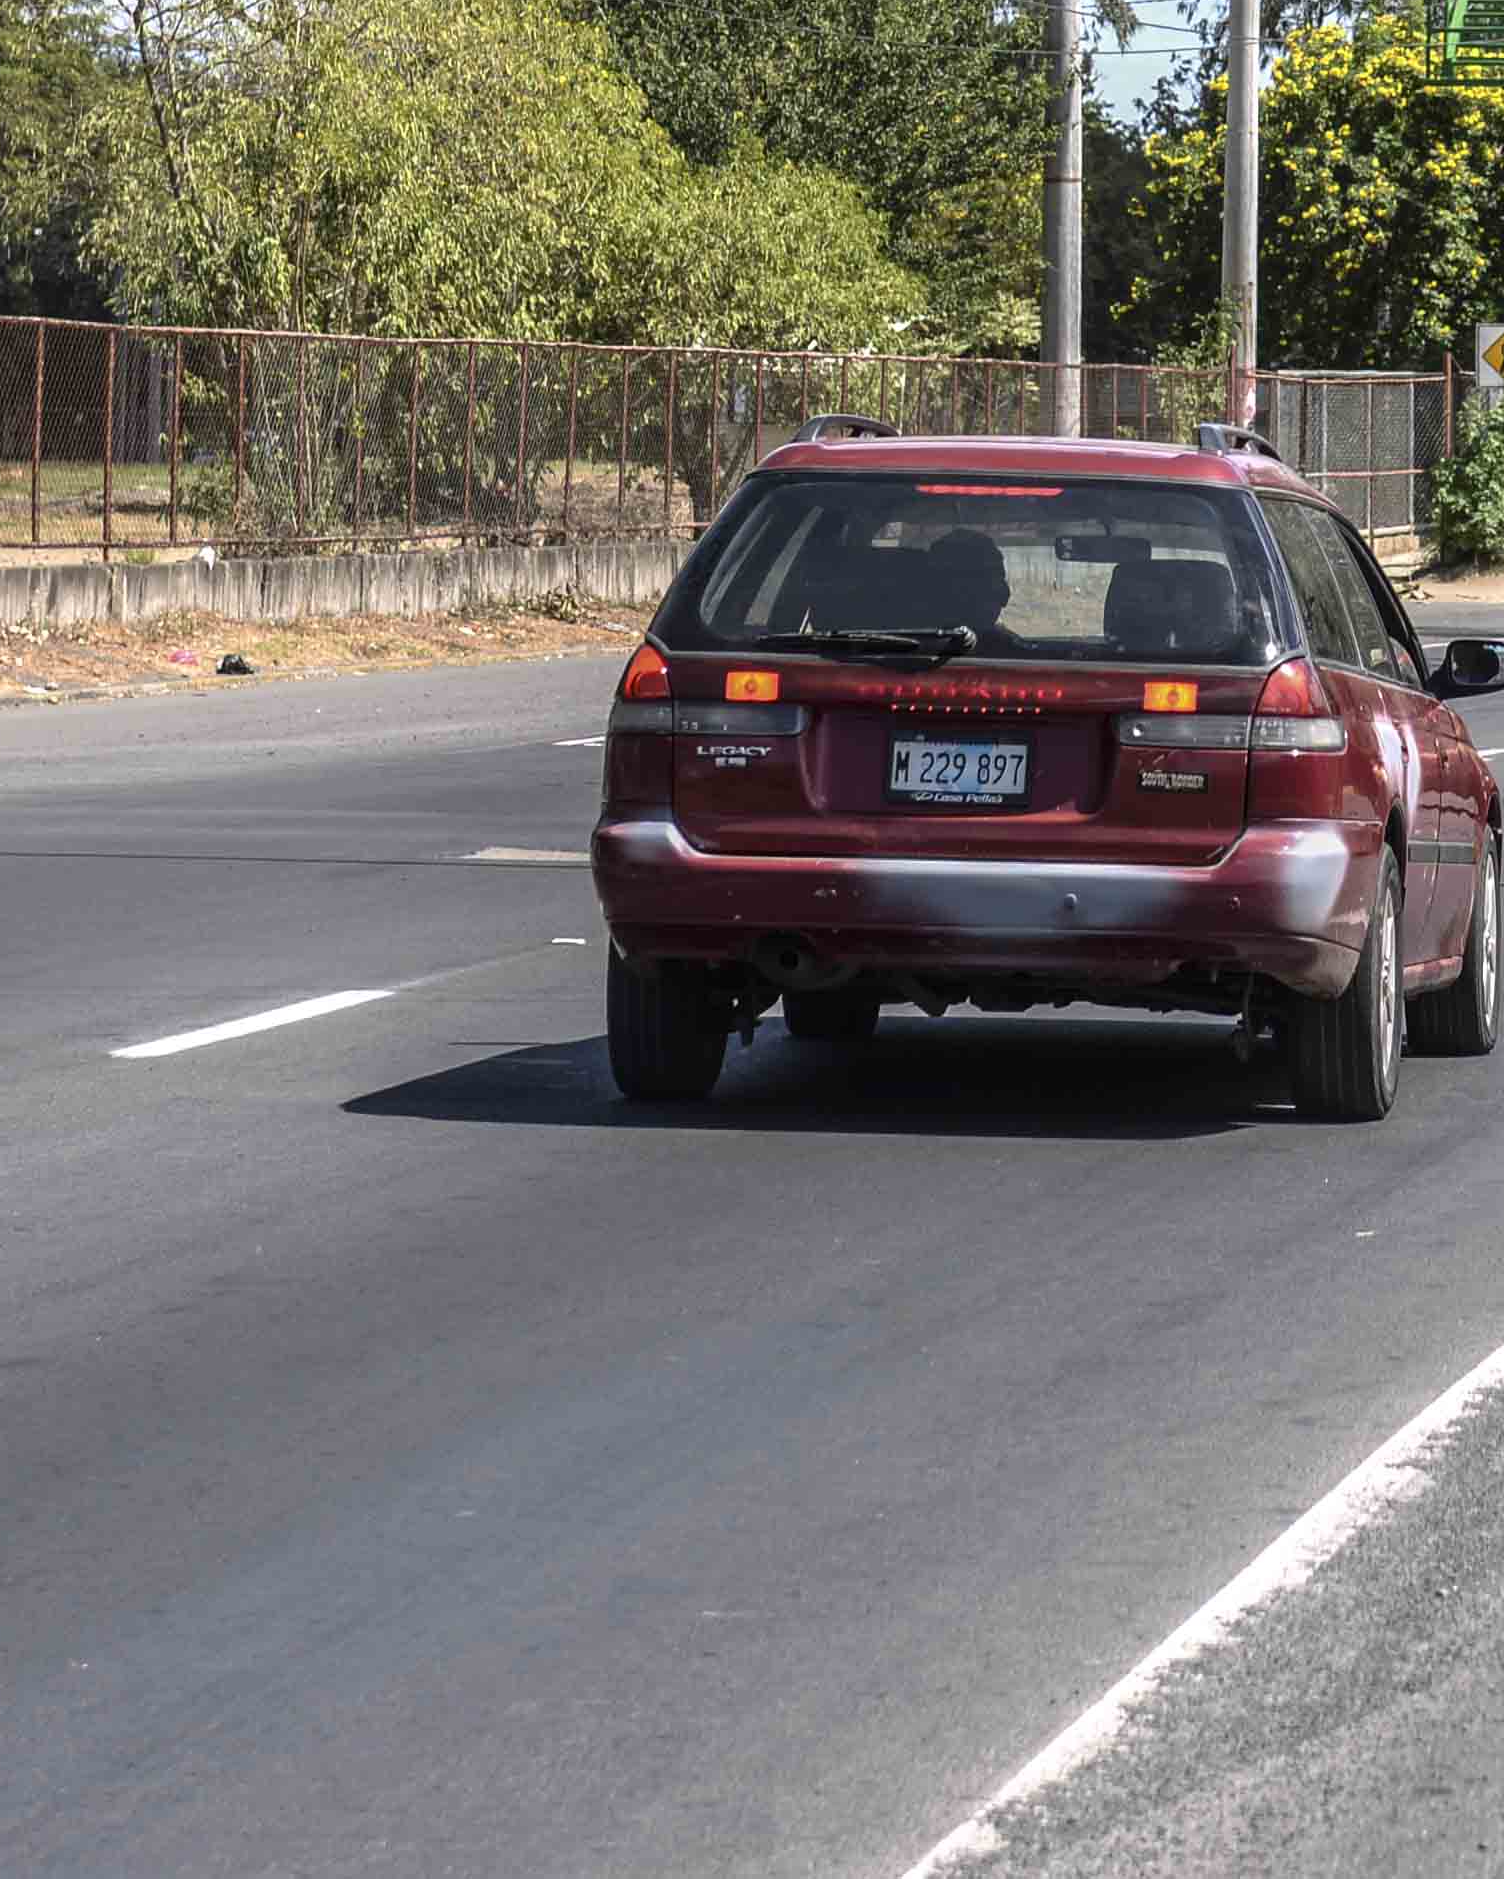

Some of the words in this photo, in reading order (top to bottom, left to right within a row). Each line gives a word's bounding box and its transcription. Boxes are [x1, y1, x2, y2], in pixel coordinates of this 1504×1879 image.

[696, 745, 772, 756] LEGACY
[894, 750, 911, 783] M
[920, 751, 967, 785] 229
[977, 754, 1025, 787] 897
